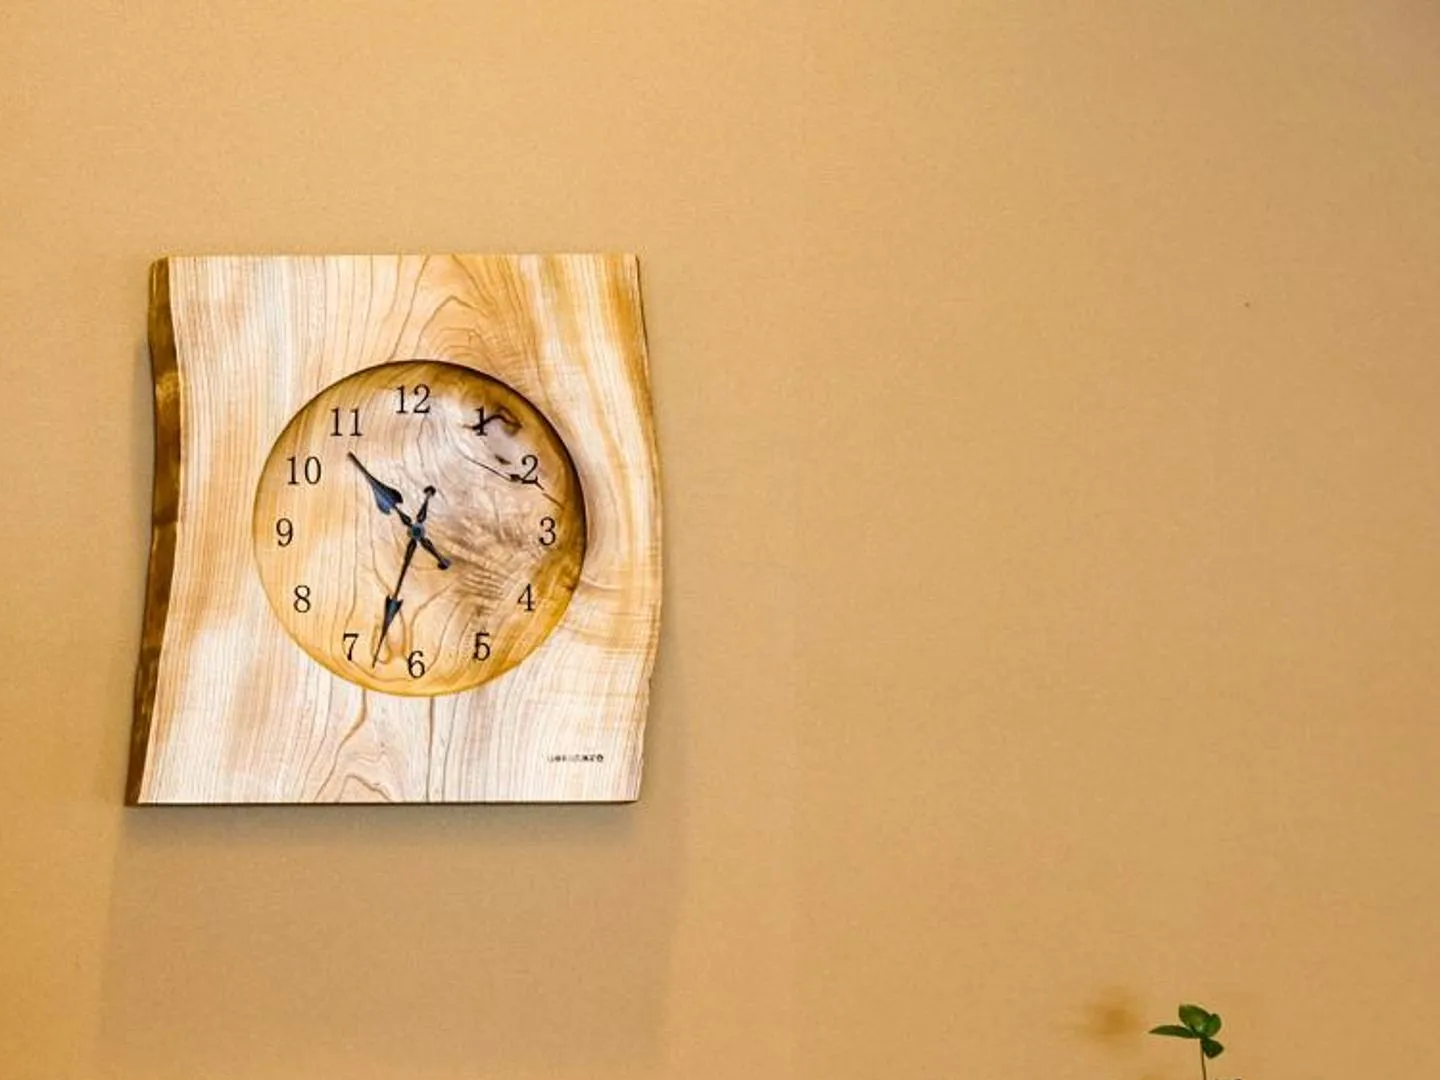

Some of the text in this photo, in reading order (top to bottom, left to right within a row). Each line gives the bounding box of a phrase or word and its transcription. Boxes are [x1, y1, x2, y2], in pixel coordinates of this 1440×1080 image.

[395, 383, 431, 414] 12
[330, 408, 363, 437] 11
[474, 406, 489, 437] 1
[287, 456, 322, 485] 10
[521, 454, 540, 484] 2
[276, 518, 294, 547] 9
[539, 517, 556, 546] 3
[294, 585, 311, 613] 8
[517, 583, 536, 612] 4
[343, 633, 359, 661] 7
[473, 632, 490, 661] 5
[408, 651, 426, 678] 6
